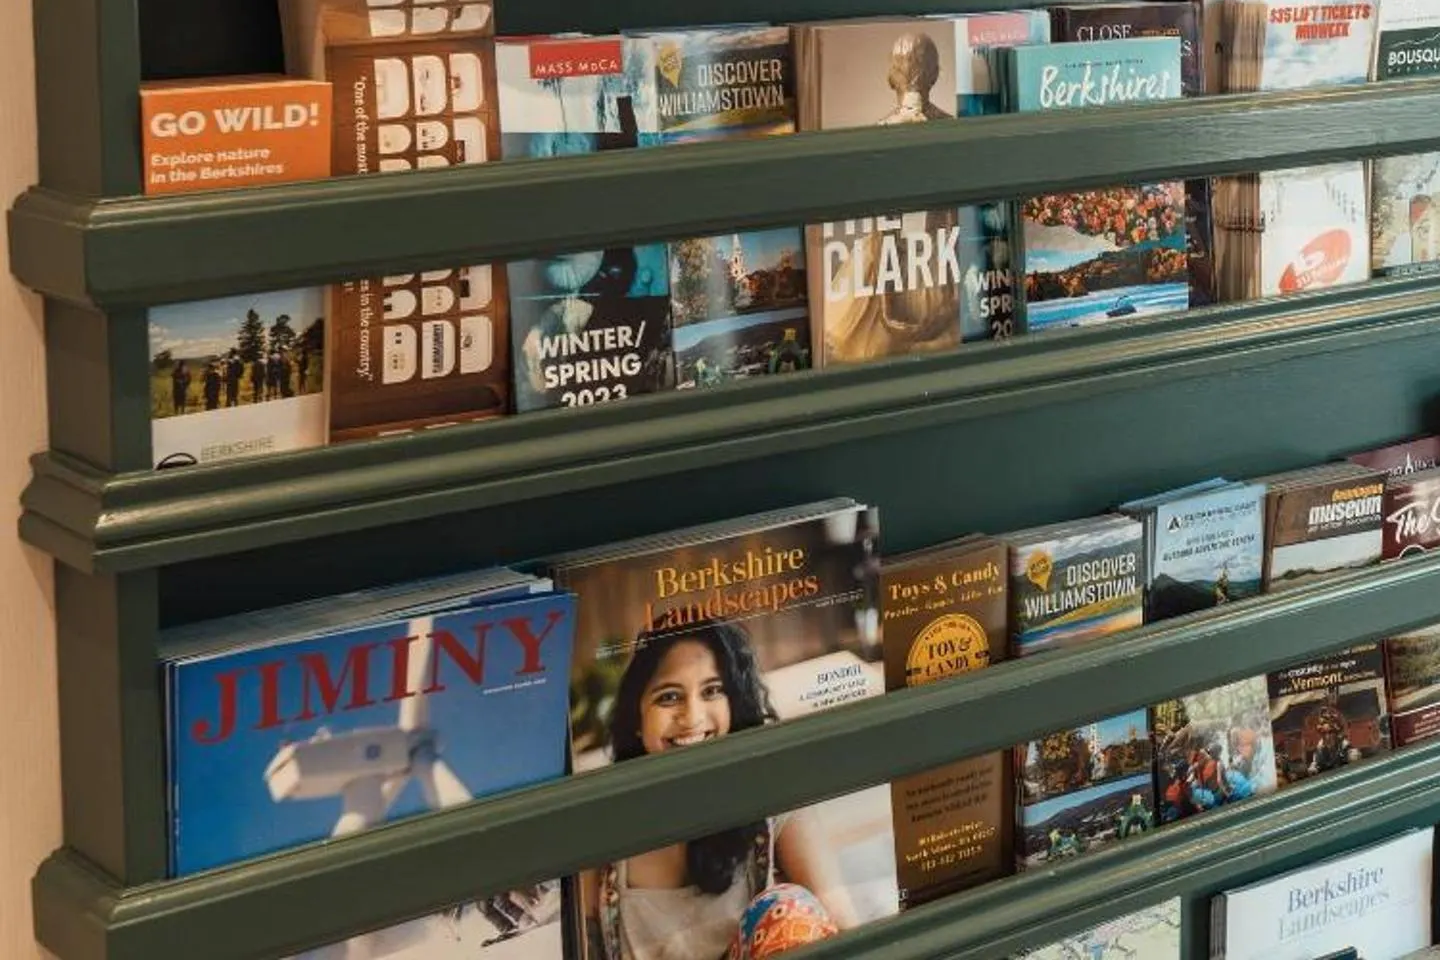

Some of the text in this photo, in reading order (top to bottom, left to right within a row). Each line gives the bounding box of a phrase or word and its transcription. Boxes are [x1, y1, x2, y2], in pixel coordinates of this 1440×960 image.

[1293, 5, 1320, 22] LIFT
[1321, 3, 1372, 20] TICKETS
[1076, 24, 1133, 42] CLOSE
[535, 60, 573, 76] MASS
[697, 58, 783, 87] DISCOVER
[1039, 61, 1171, 108] Berkshires
[150, 102, 320, 138] GO WILD!
[354, 107, 370, 120] of
[659, 86, 785, 118] WILLIAMSTOWN
[355, 120, 370, 142] the
[150, 146, 271, 169] Explore nature
[150, 161, 284, 185] in the Berkshires
[823, 226, 960, 303] CLARK
[538, 319, 646, 360] WINTER/
[544, 352, 642, 389] SPRING
[1308, 494, 1382, 526] museum
[1386, 500, 1429, 544] The
[655, 547, 806, 599] Berkshire
[888, 561, 1001, 601] Toys & Candy
[1066, 552, 1137, 588] DISCOVER
[640, 574, 821, 633] Landscapes
[1024, 577, 1138, 619] WILLIAMSTOWN
[191, 610, 566, 745] JIMINY
[1291, 670, 1344, 691] Vermont
[1287, 866, 1384, 913] Berkshire
[1277, 890, 1390, 941] Landscapes
